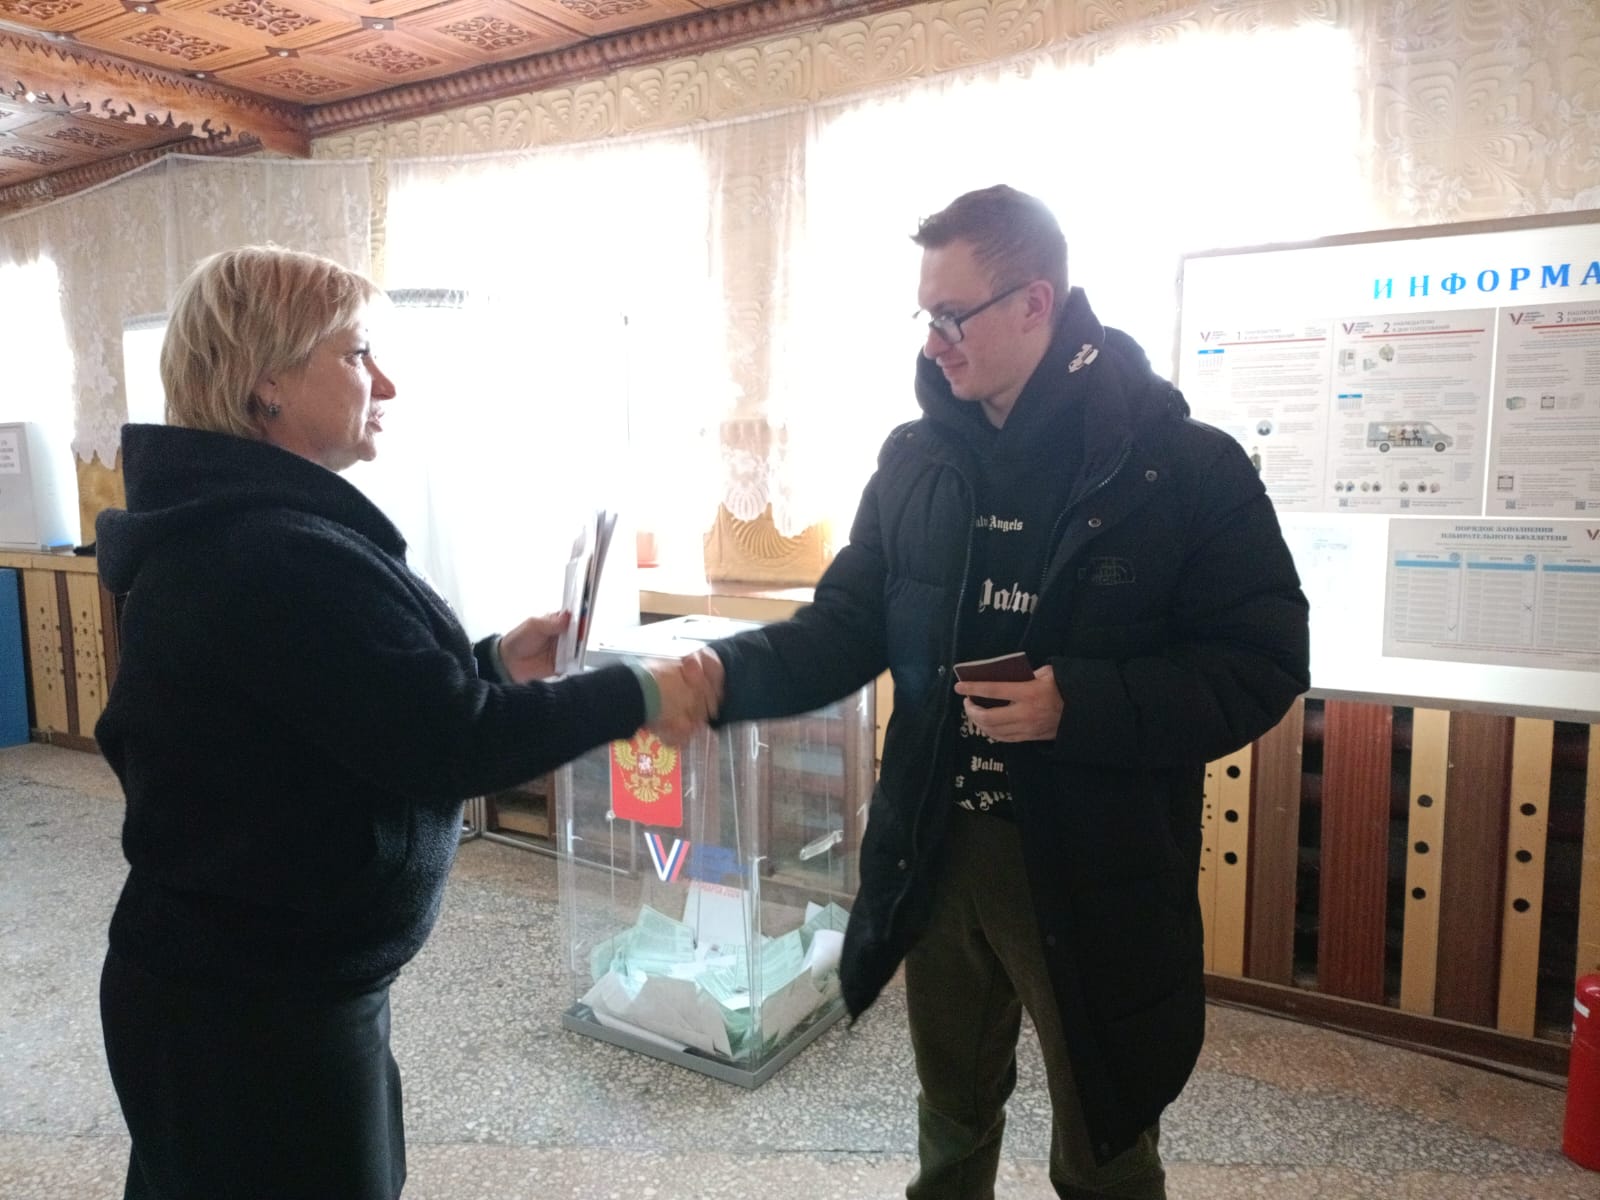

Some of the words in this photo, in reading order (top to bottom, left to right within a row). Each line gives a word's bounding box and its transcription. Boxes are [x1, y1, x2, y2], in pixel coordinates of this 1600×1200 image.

[1556, 311, 1564, 323] 3
[1383, 322, 1391, 333] 2
[989, 514, 1024, 532] Angels
